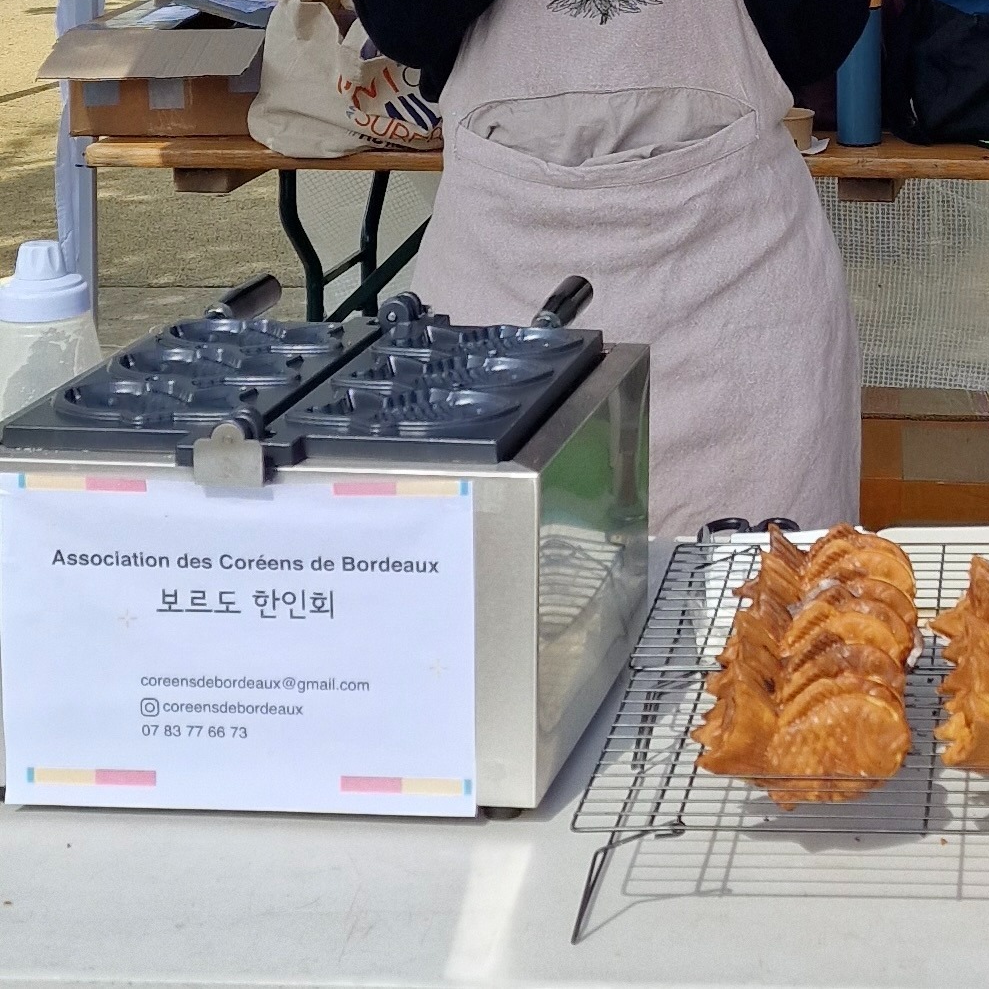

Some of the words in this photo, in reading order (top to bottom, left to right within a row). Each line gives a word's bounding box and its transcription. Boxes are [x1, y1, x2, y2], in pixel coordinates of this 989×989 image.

[52, 549, 169, 568] Association
[177, 553, 212, 569] des
[219, 554, 304, 571] Coréens
[311, 556, 335, 571] de
[342, 556, 439, 573] Bordeaux
[156, 589, 241, 614] 보르도
[252, 589, 334, 619] 한인회
[141, 675, 369, 693] coreensdebordeaux@gmail.com
[163, 701, 303, 715] coreensdebordeaux
[142, 724, 159, 736] 07
[164, 725, 181, 737] 83
[186, 725, 203, 737] 77
[208, 726, 225, 738] 66
[230, 726, 247, 739] 73
